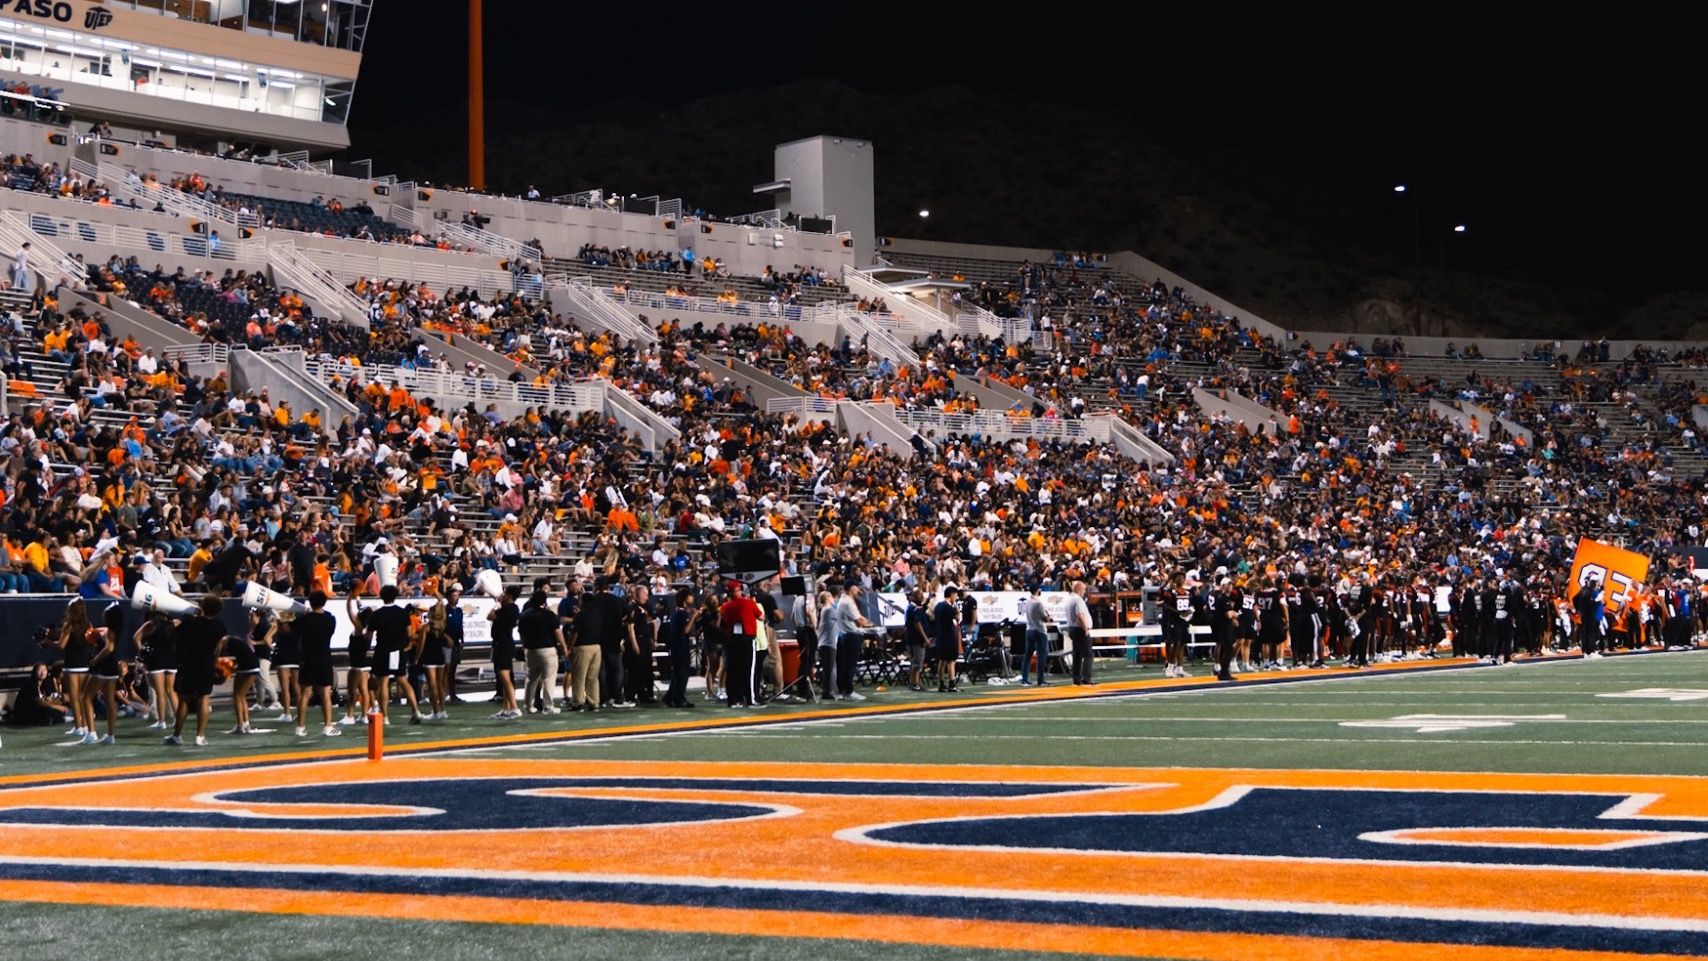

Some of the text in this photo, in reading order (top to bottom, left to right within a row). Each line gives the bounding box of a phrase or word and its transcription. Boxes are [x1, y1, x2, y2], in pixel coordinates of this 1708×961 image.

[84, 6, 113, 30] UTEP
[1242, 597, 1255, 609] 57
[1257, 597, 1273, 610] 97
